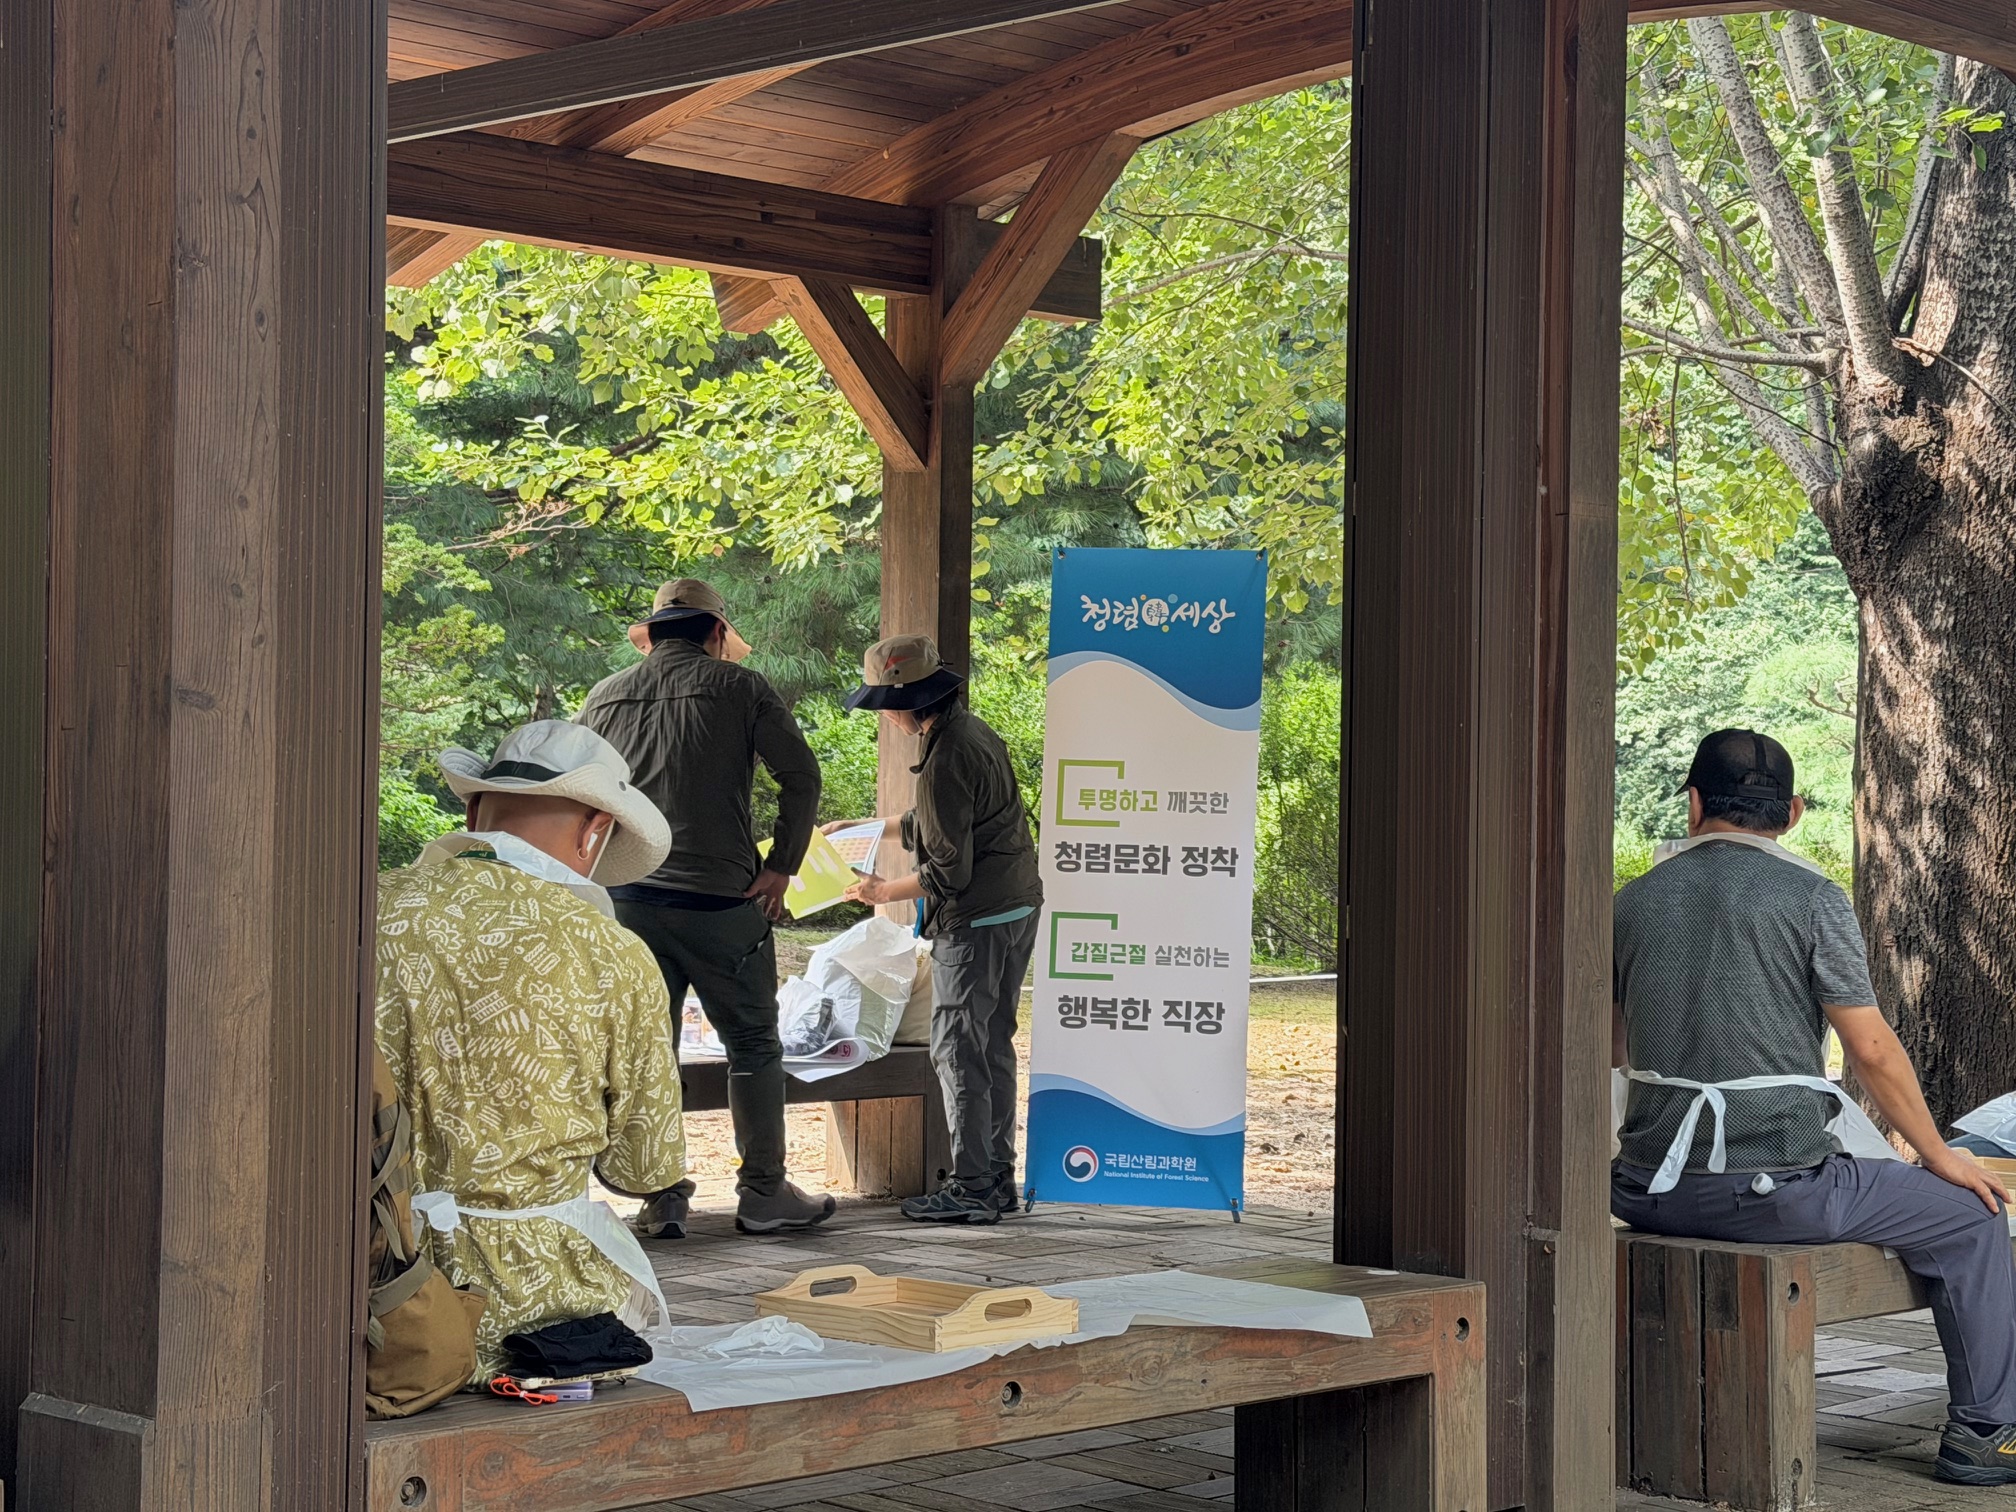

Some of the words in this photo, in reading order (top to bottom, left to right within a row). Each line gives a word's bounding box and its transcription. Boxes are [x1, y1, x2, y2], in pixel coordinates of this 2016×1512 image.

[1078, 788, 1158, 812] 투명하고
[1166, 791, 1230, 815] 깨끗한
[1054, 841, 1171, 876] 청렴문화
[1180, 845, 1239, 878] 정착
[1071, 942, 1146, 965] 갑질근절
[1154, 945, 1230, 968] 실천하는
[1057, 994, 1152, 1032] 행복한
[1161, 1000, 1226, 1035] 직장
[1104, 1153, 1196, 1171] 국립산림과학원
[1185, 1174, 1209, 1182] Science
